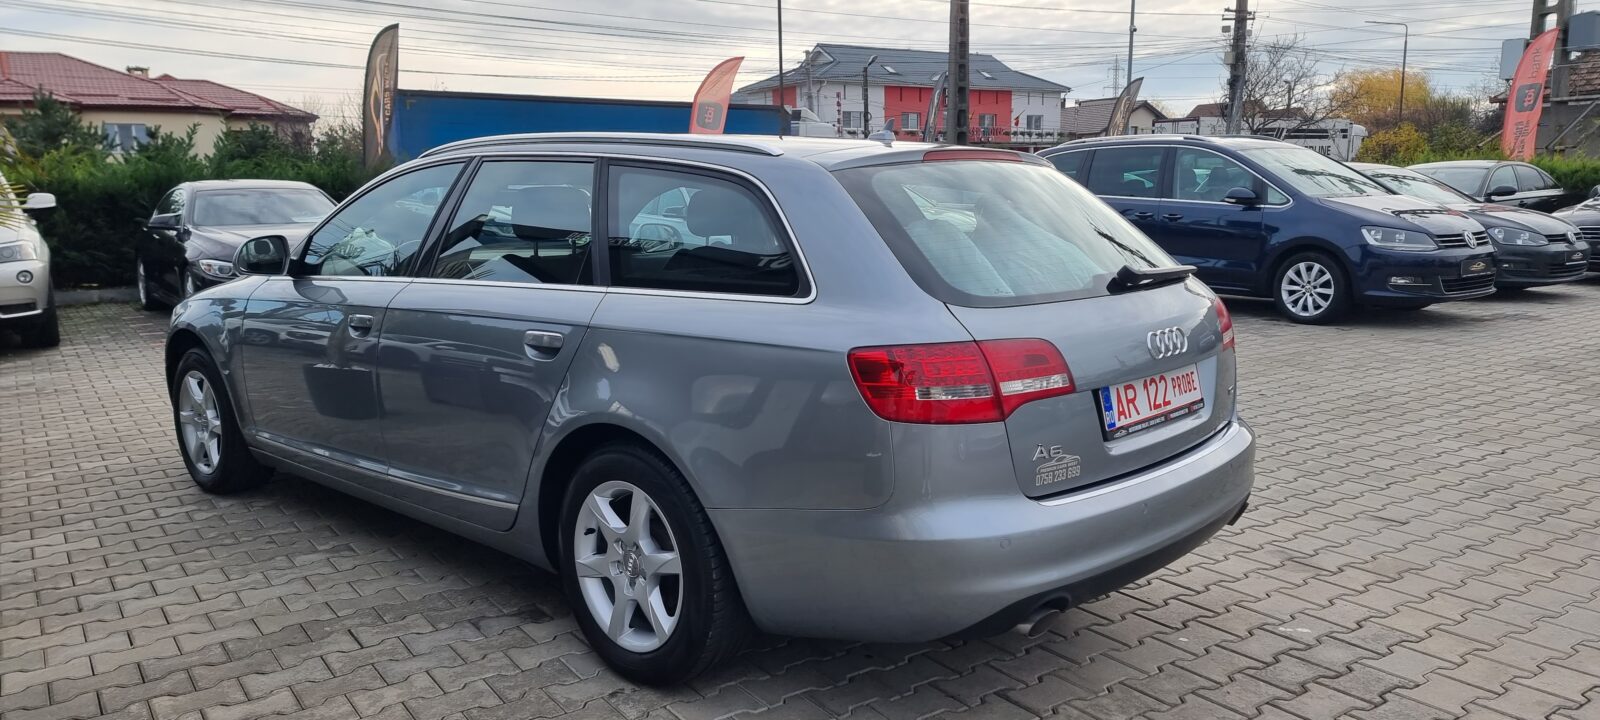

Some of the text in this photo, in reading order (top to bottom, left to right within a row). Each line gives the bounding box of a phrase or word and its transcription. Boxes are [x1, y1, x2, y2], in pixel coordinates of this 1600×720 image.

[1116, 371, 1197, 422] AR 122 PROBE
[1106, 411, 1115, 424] RO
[1033, 444, 1063, 461] A6
